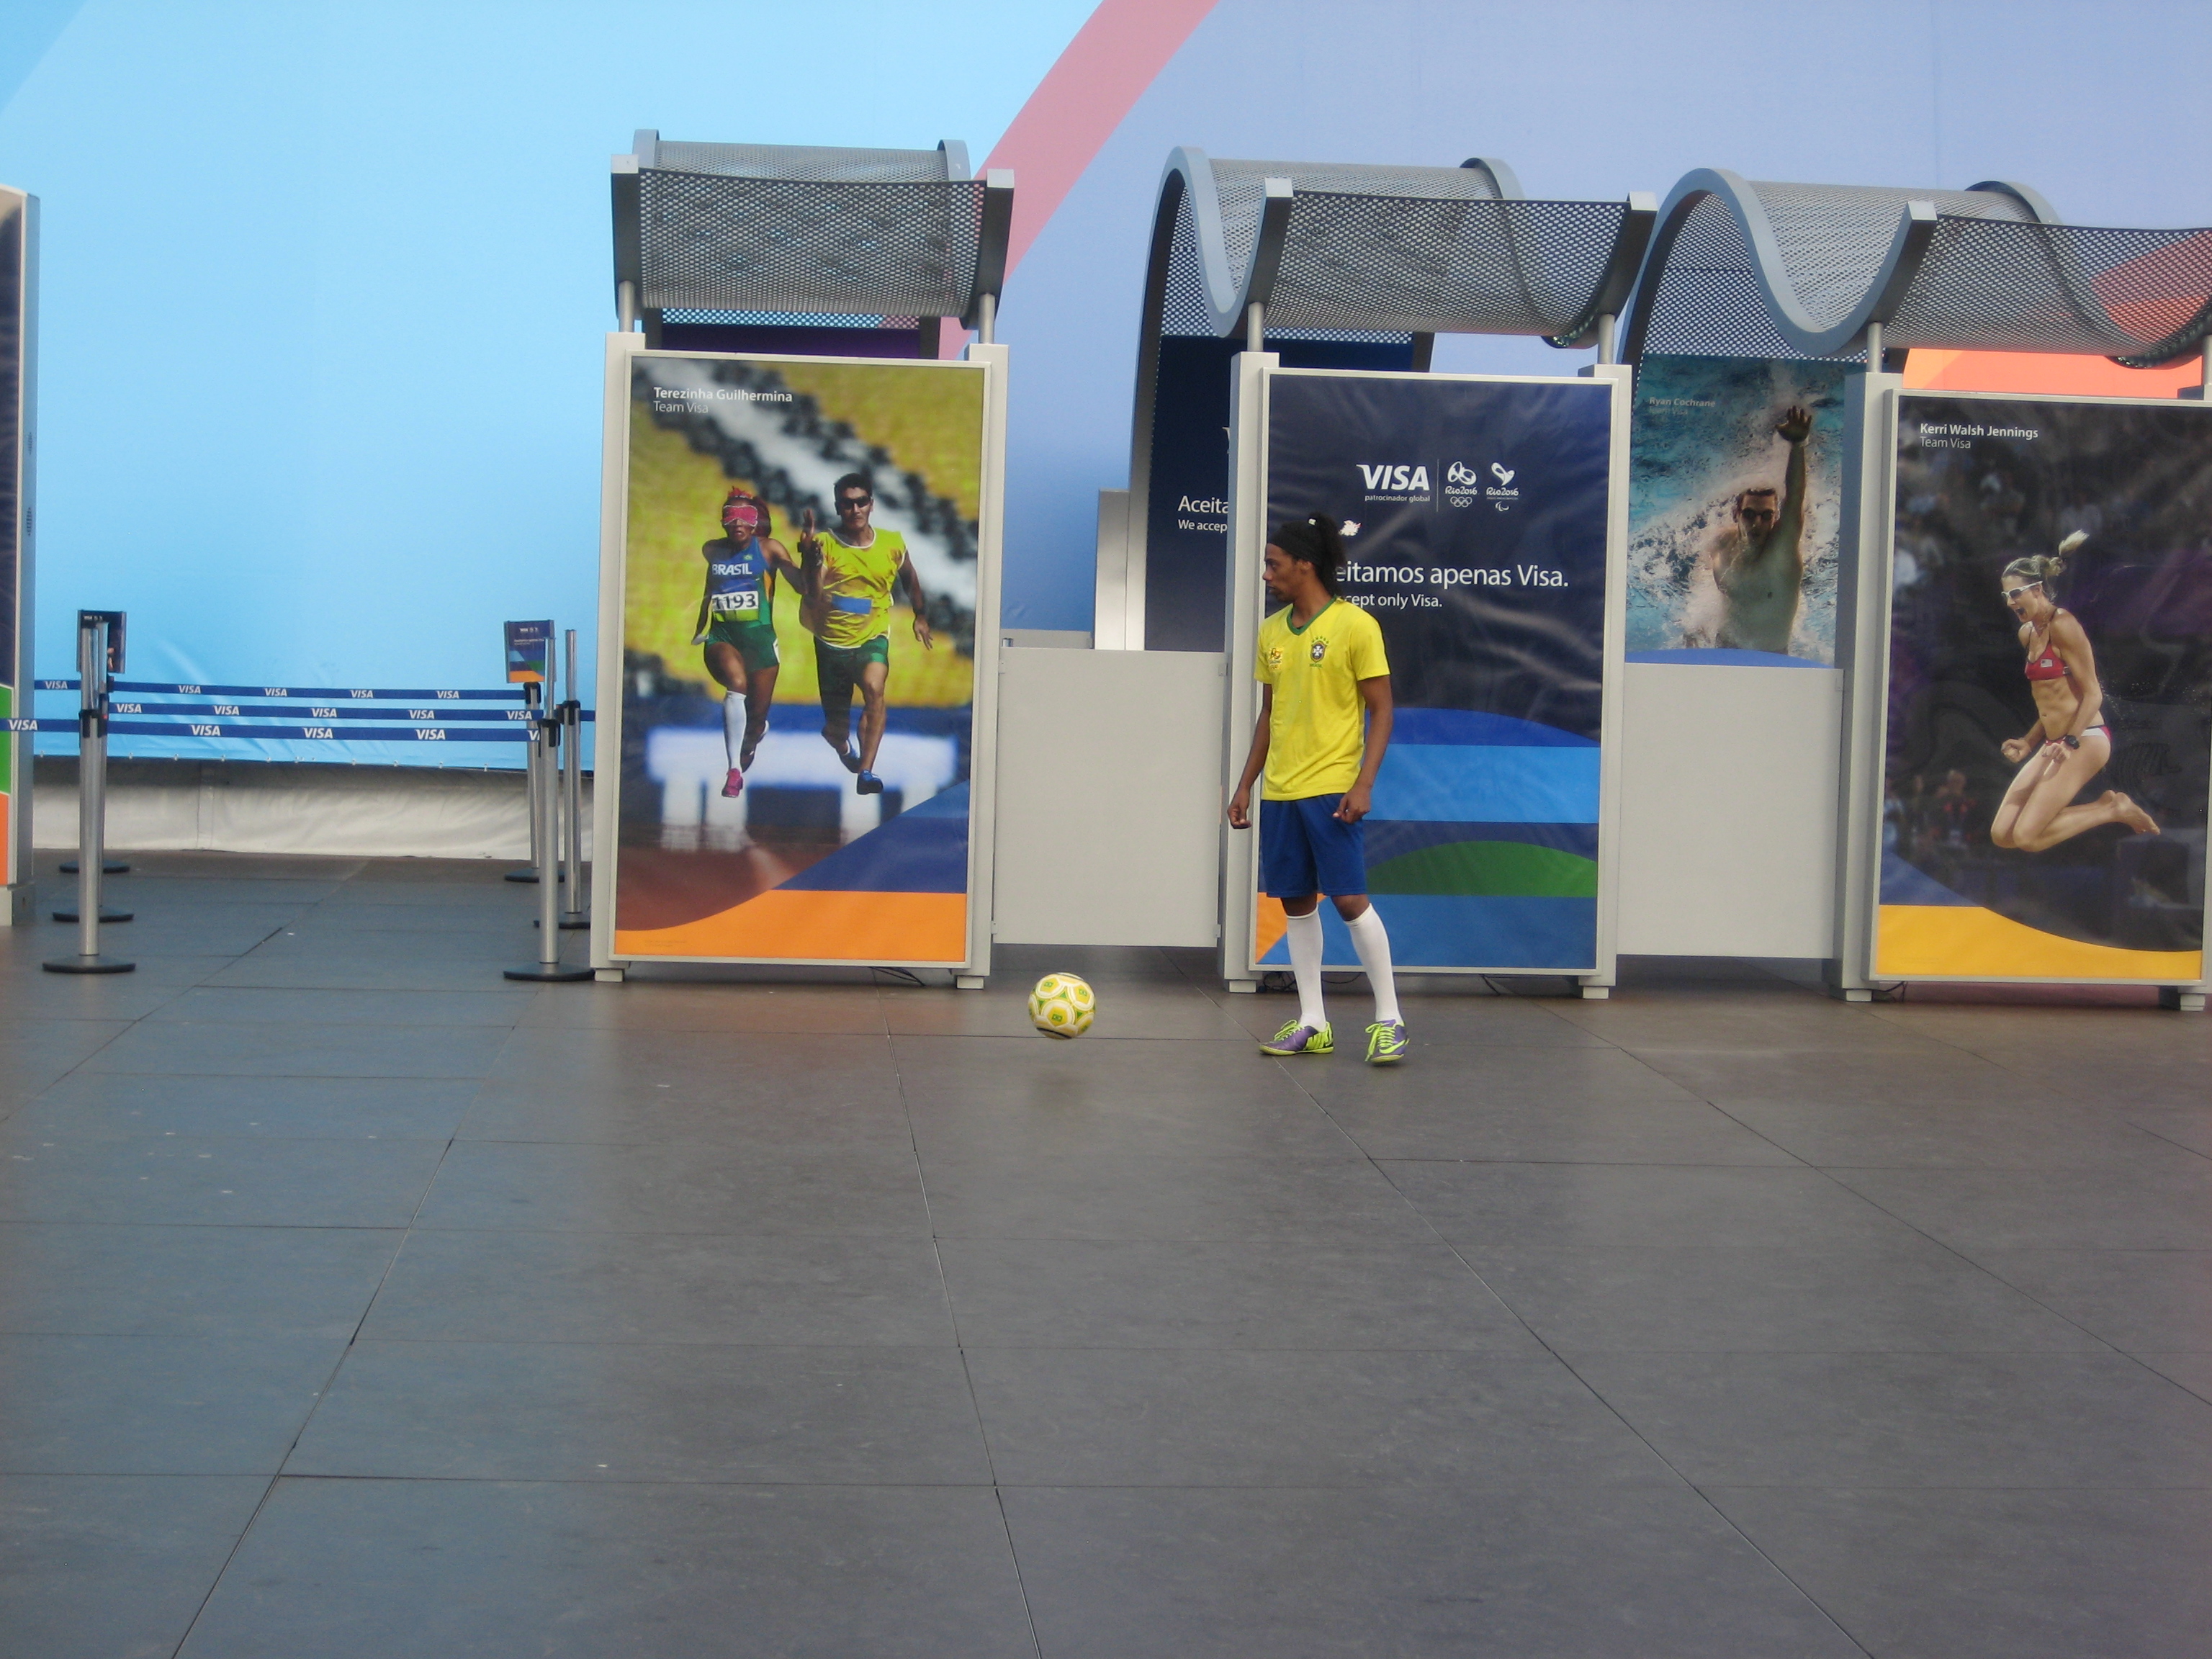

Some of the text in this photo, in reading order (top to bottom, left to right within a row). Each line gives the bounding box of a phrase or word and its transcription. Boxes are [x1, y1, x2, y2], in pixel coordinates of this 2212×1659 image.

[654, 387, 792, 402] Terezinha Guilhermina
[653, 400, 709, 413] Team Visa
[1650, 397, 1715, 408] Ryan Cochrane
[1920, 423, 2038, 441] Kerri Walsh Jennings
[1920, 436, 1972, 449] Team Visa
[1356, 464, 1430, 491] VISA
[1364, 495, 1408, 503] patrocinador
[1178, 519, 1195, 530] We
[712, 563, 752, 575] BRASIL
[1430, 567, 1511, 590] apenas
[1517, 565, 1569, 587] Visa.
[713, 593, 756, 609] 1193
[1377, 593, 1408, 610] only
[1411, 594, 1442, 607] Visa.
[45, 680, 68, 690] VISA
[178, 685, 202, 694] VISA
[264, 688, 288, 697] VISA
[350, 690, 373, 698] VISA
[436, 691, 459, 699] VISA
[117, 703, 142, 714] VISA
[214, 705, 240, 715] VISA
[311, 708, 337, 717] VISA
[409, 710, 434, 719] VISA
[506, 711, 532, 719] VISA
[9, 720, 38, 731] VISA
[191, 725, 220, 736] VISA
[303, 727, 333, 739] VISA
[415, 729, 446, 740] VISA
